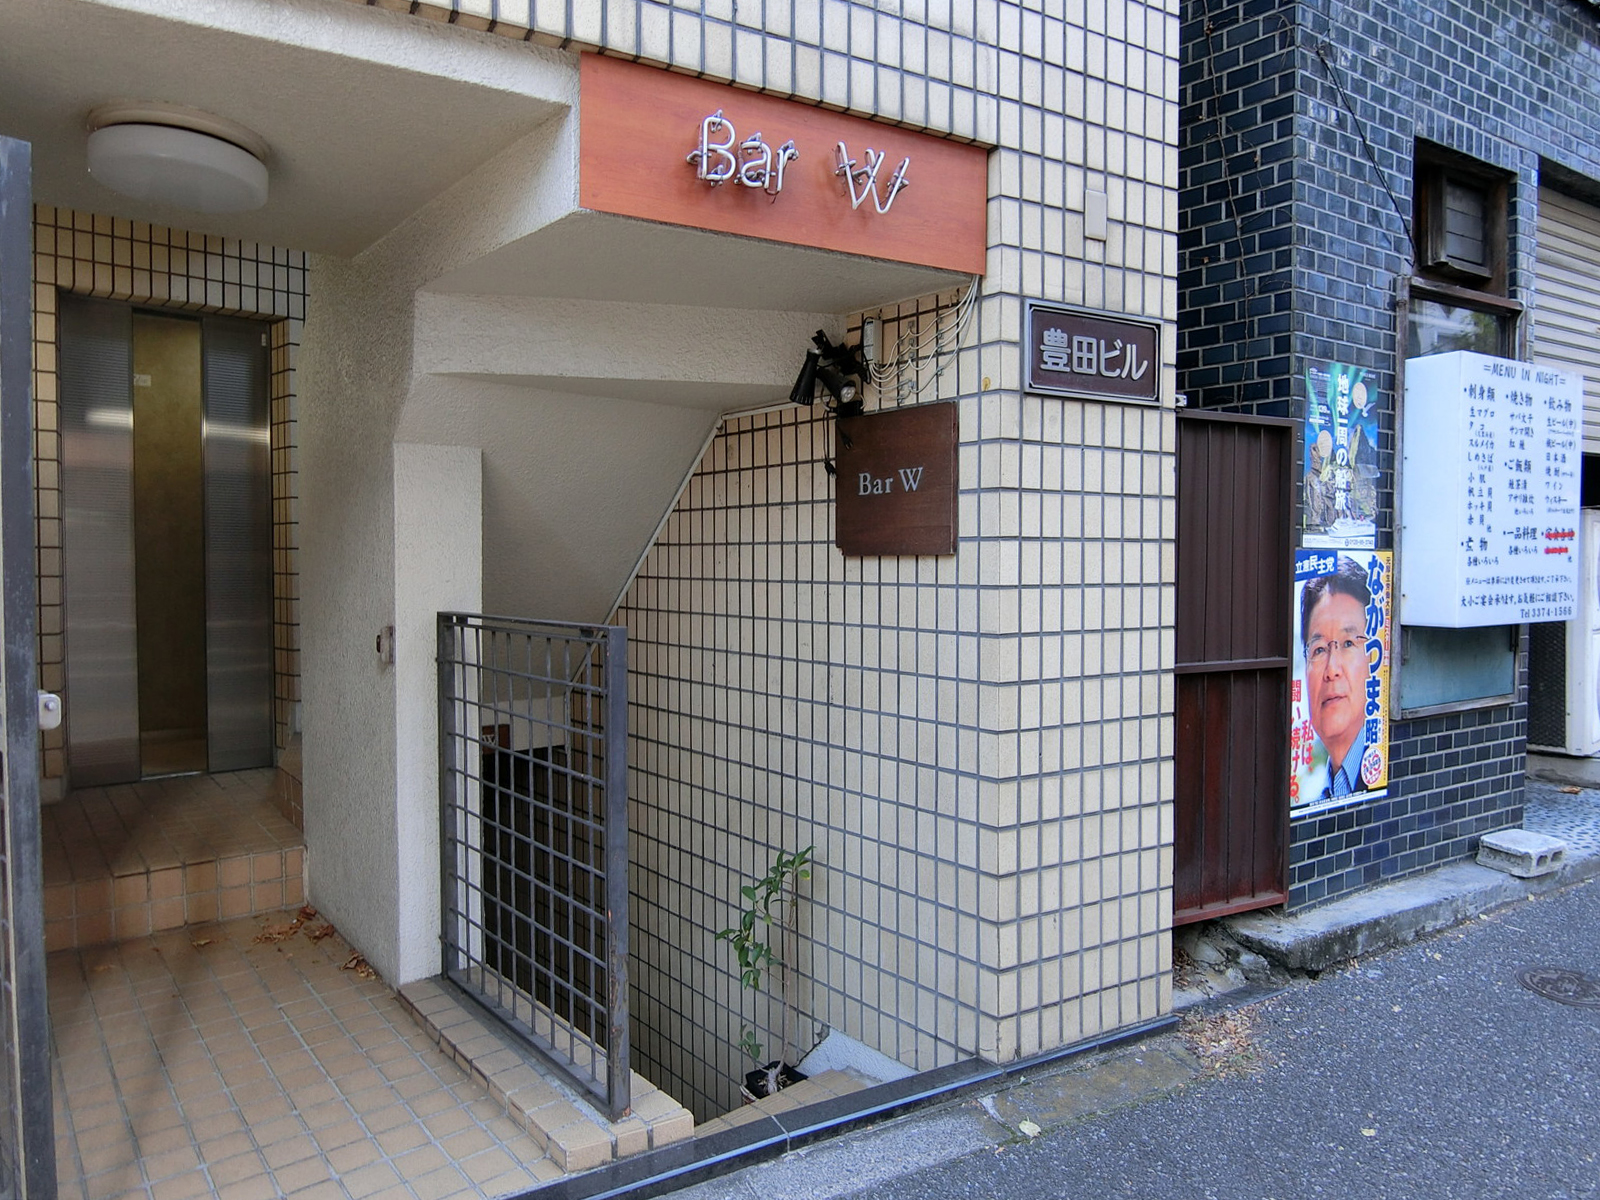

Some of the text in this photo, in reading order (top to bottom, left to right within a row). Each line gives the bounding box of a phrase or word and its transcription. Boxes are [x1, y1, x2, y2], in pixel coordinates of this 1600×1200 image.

[699, 113, 909, 214] Bar W
[1040, 328, 1148, 380] 豊田ビル
[1522, 368, 1530, 381] IN
[1334, 373, 1350, 511] 地球一周の船旅
[858, 467, 923, 496] Bar W
[1294, 554, 1335, 576] 立憲民主党
[1532, 606, 1572, 618] 3374-1566
